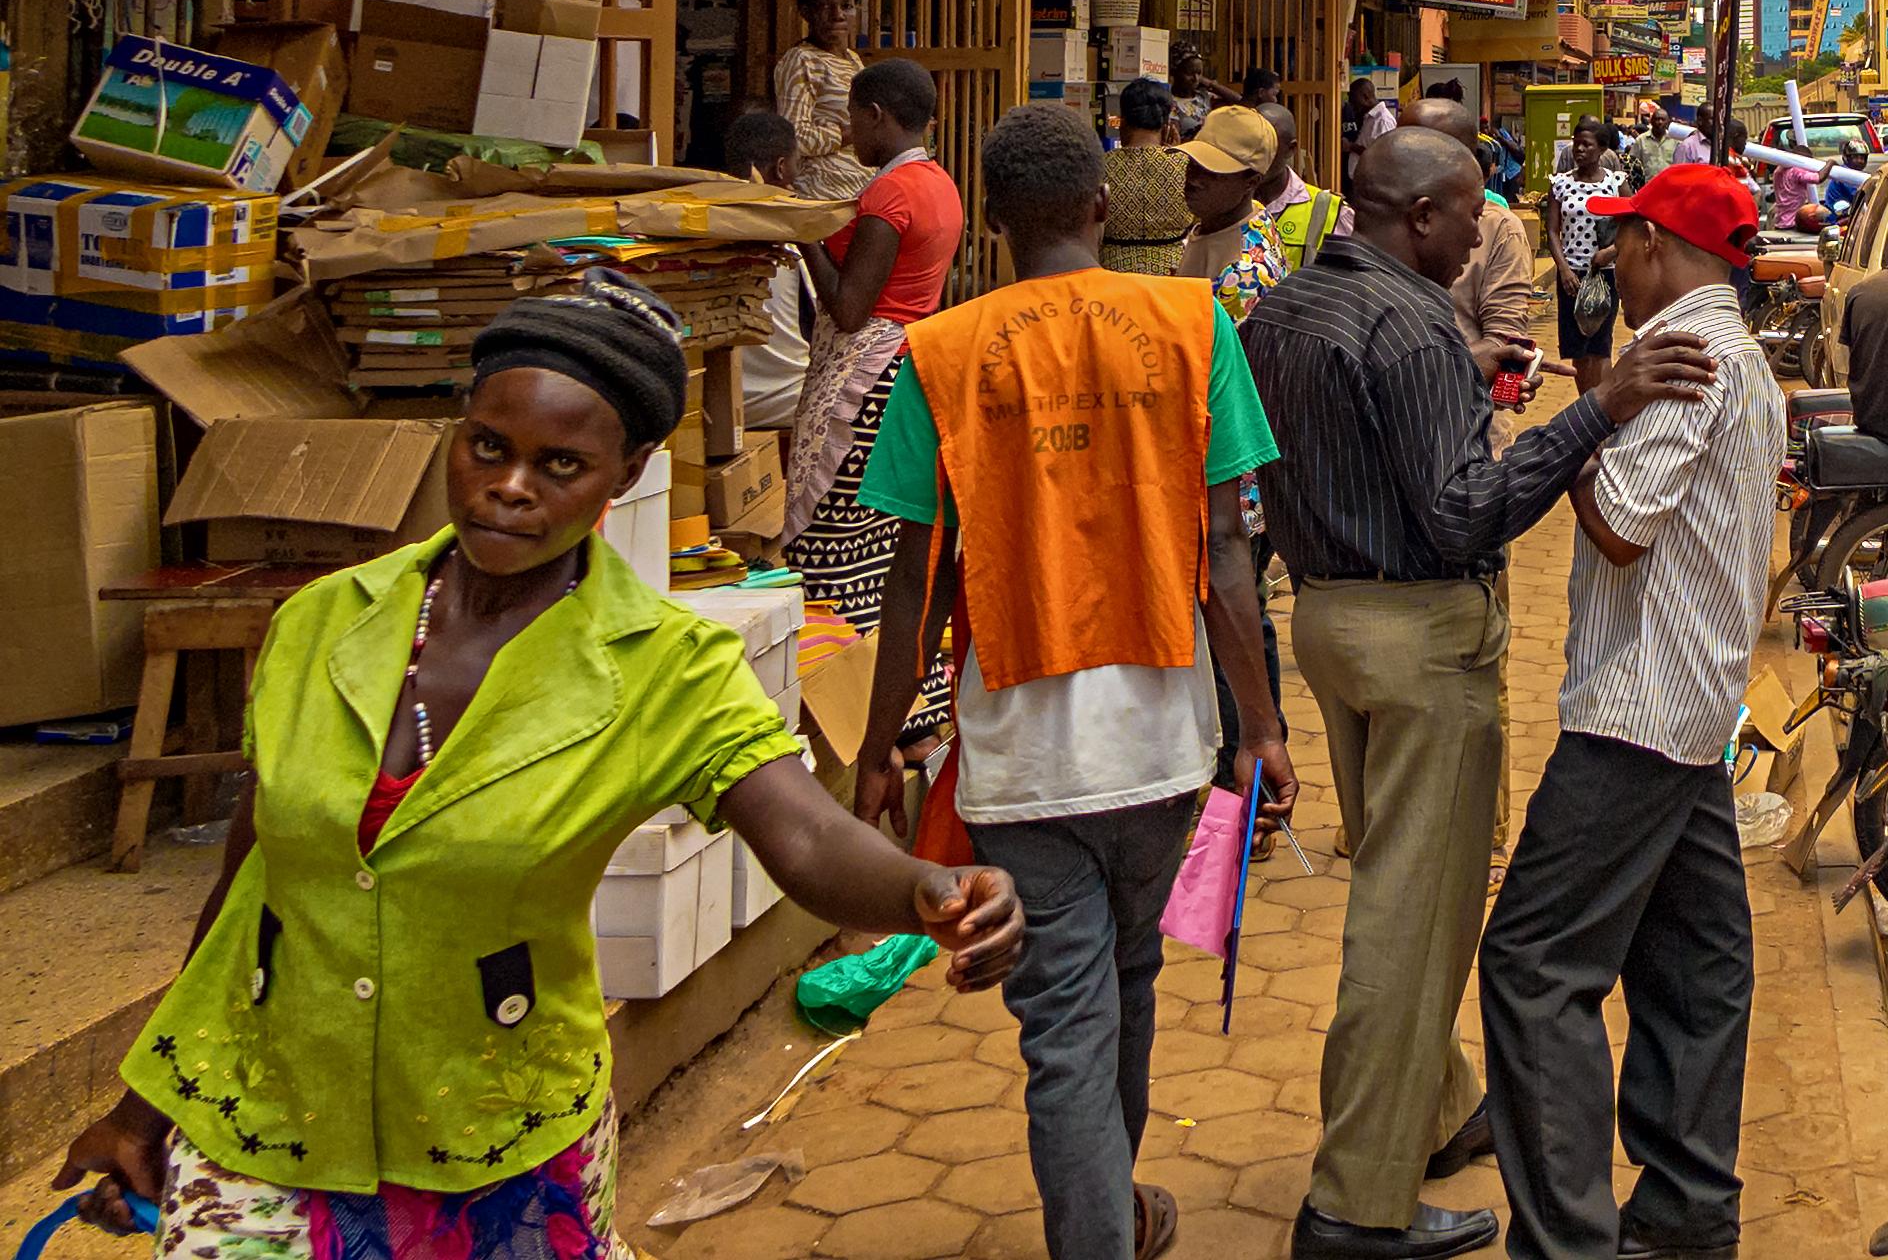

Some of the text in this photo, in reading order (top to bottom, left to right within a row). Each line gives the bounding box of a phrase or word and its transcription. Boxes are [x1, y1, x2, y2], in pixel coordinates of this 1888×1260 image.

[130, 48, 220, 82] Double
[1593, 56, 1650, 79] BULK SMS
[977, 296, 1166, 397] PARKING CONTROL
[1114, 390, 1159, 409] LTD
